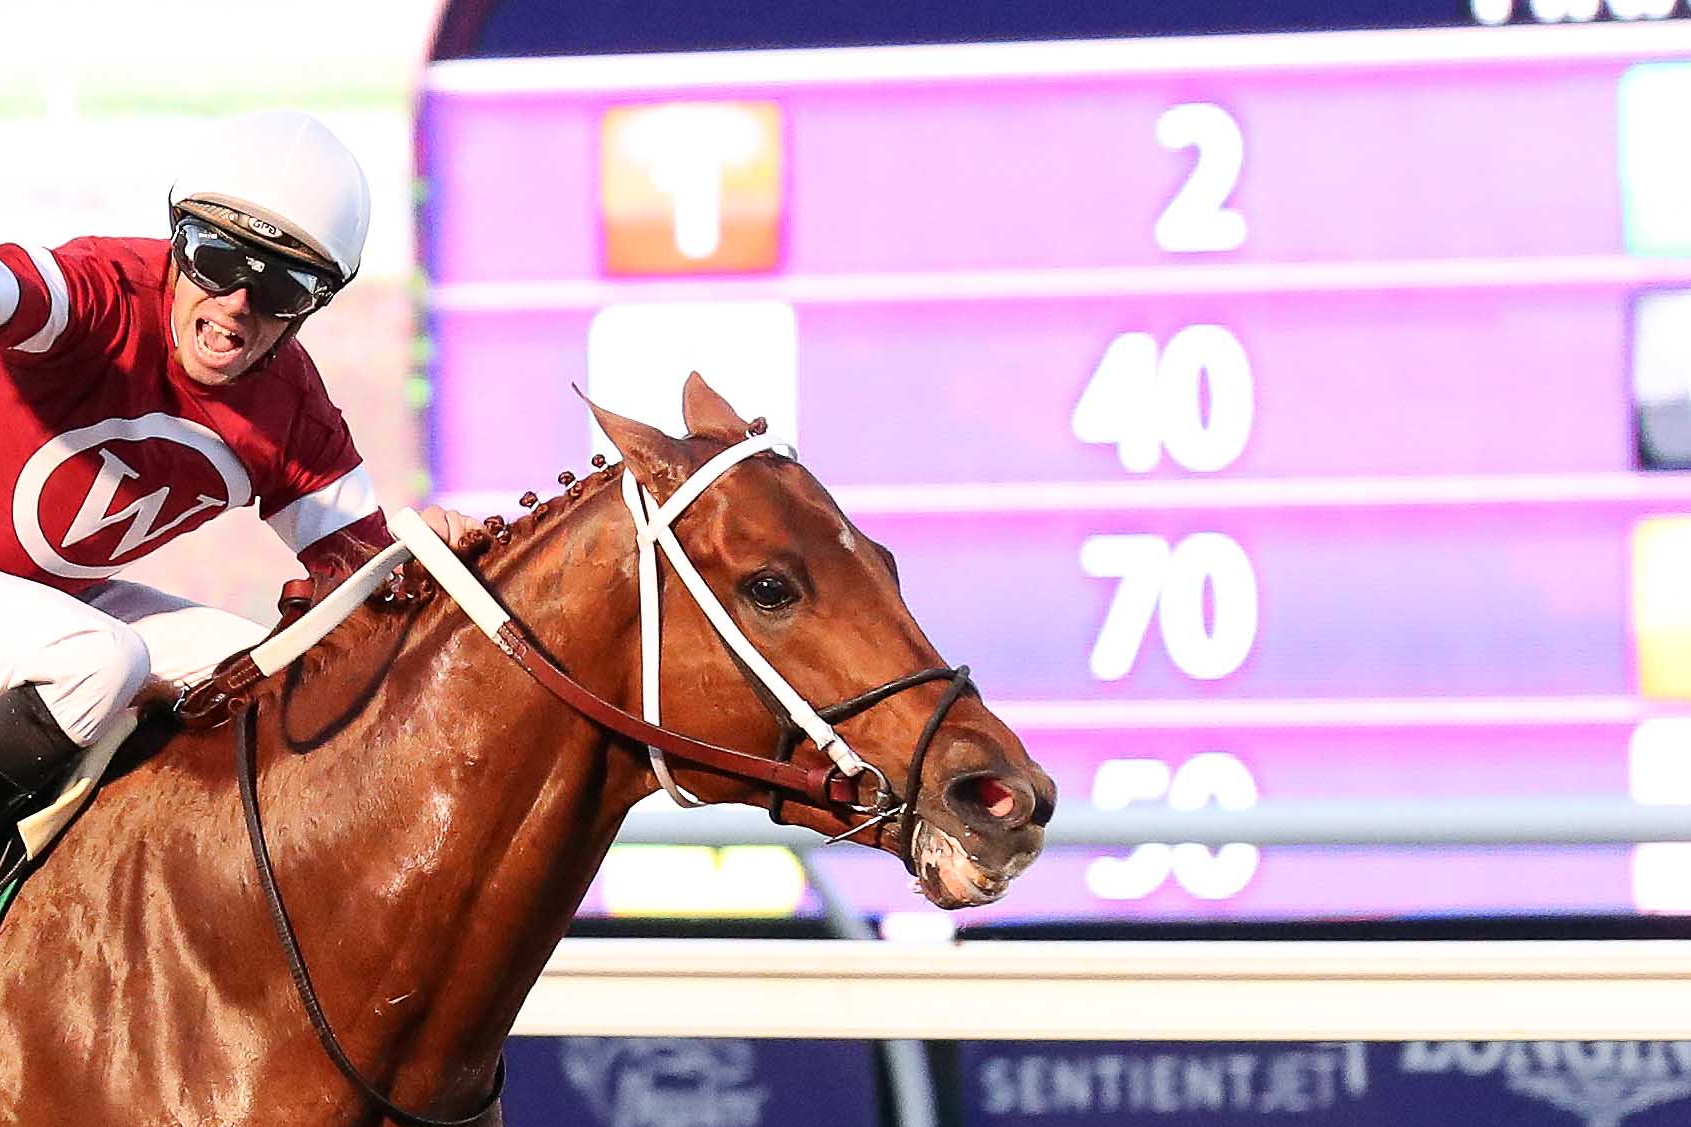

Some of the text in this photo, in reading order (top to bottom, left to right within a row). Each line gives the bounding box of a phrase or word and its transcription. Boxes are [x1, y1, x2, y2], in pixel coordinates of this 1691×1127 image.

[1155, 101, 1248, 252] 2
[1070, 322, 1254, 472] 40
[62, 446, 228, 563] W
[1081, 533, 1258, 681] 70
